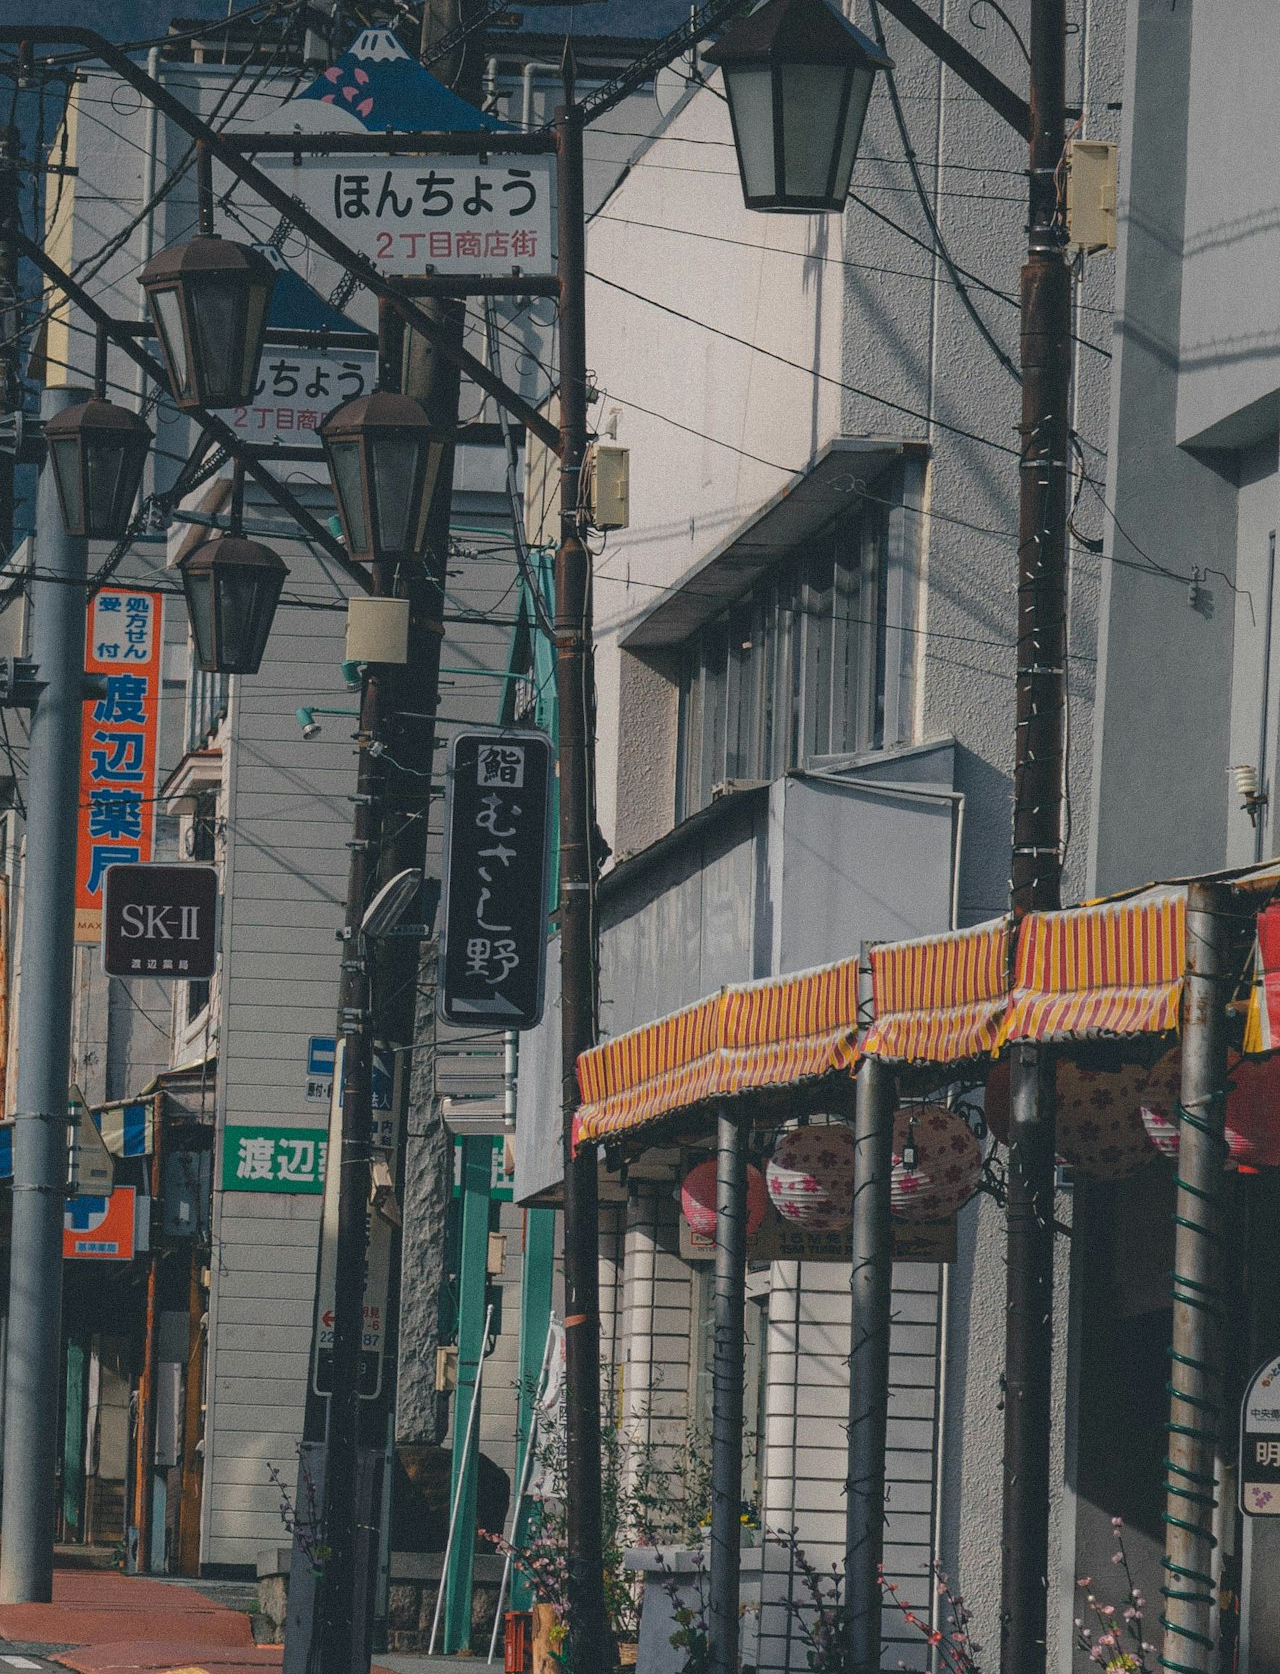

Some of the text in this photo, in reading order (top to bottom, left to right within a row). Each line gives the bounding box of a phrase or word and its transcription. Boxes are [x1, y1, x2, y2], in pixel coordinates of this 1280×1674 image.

[334, 168, 538, 220] ほんちょう
[375, 229, 538, 260] 2丁目商店街
[97, 596, 121, 659] 受付
[125, 597, 149, 660] 処方せん
[465, 748, 523, 985] 鮨 むさし野
[236, 1136, 327, 1182] 渡辺
